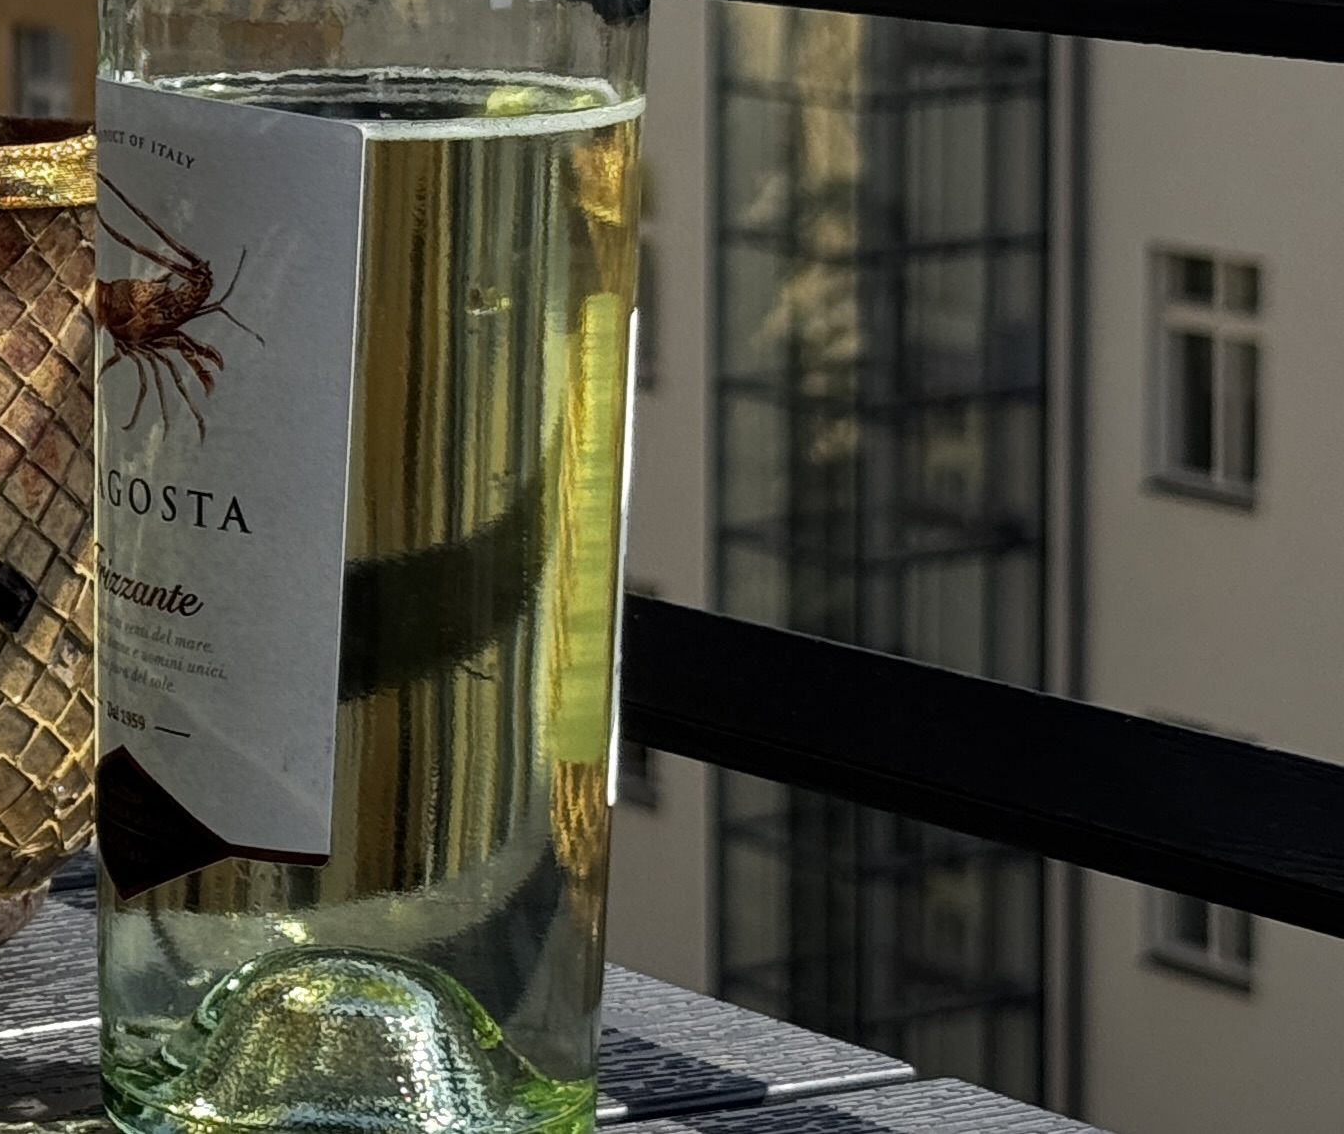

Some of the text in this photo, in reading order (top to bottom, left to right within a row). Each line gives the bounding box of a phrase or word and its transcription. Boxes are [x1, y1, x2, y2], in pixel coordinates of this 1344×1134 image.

[128, 133, 145, 149] OF
[150, 140, 196, 169] ITALY
[151, 626, 172, 645] del
[130, 665, 149, 684] del
